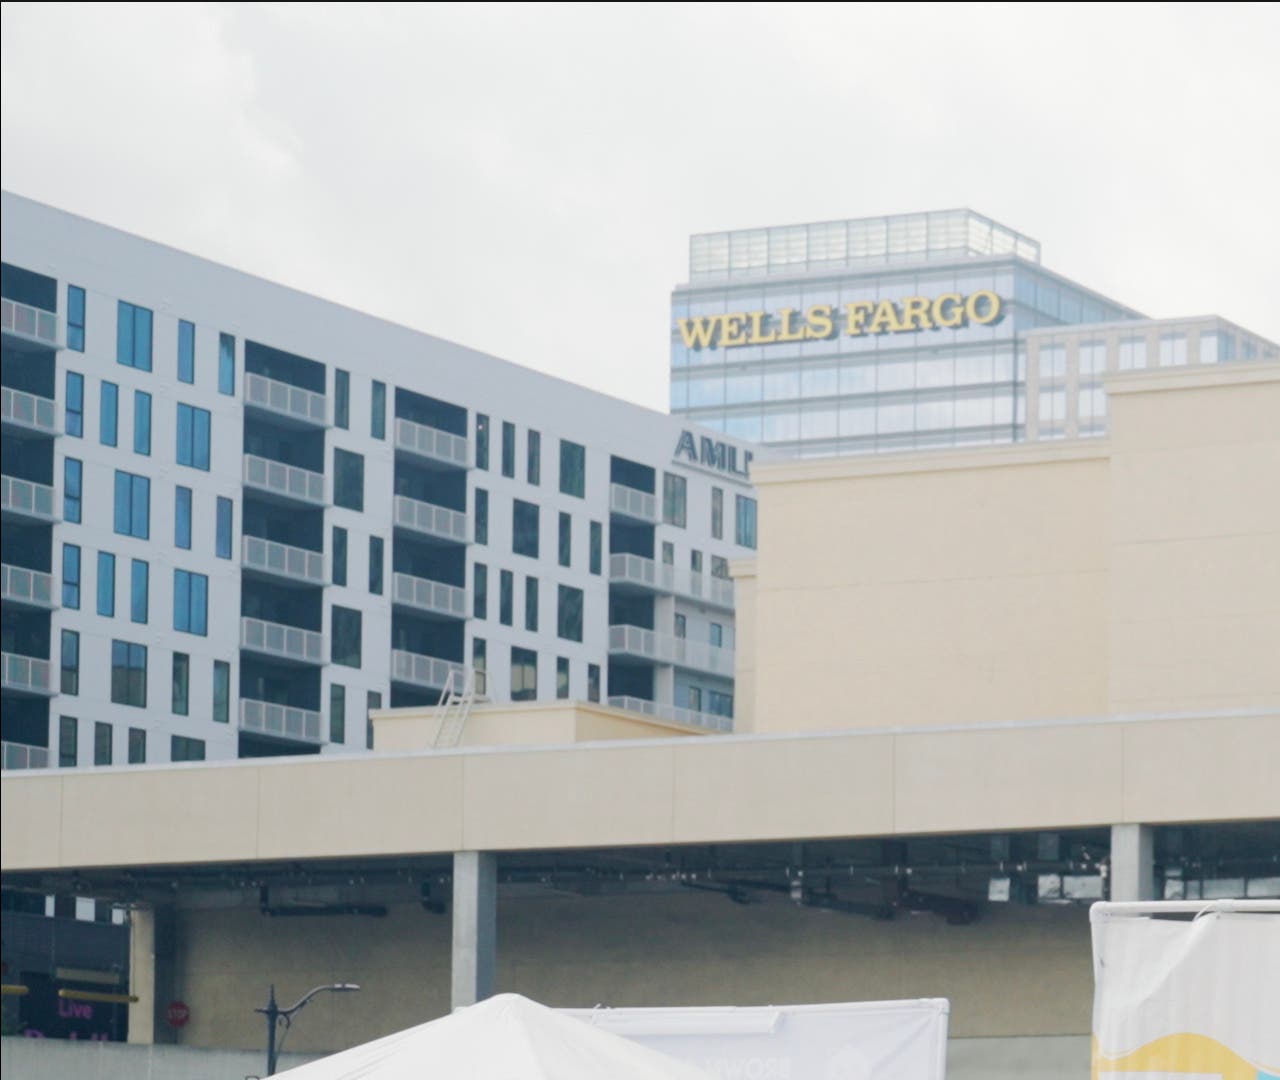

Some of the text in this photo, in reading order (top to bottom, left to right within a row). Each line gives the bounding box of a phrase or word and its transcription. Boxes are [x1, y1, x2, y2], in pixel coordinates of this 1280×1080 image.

[677, 290, 1002, 350] WELLS FARGO
[58, 999, 94, 1019] Live
